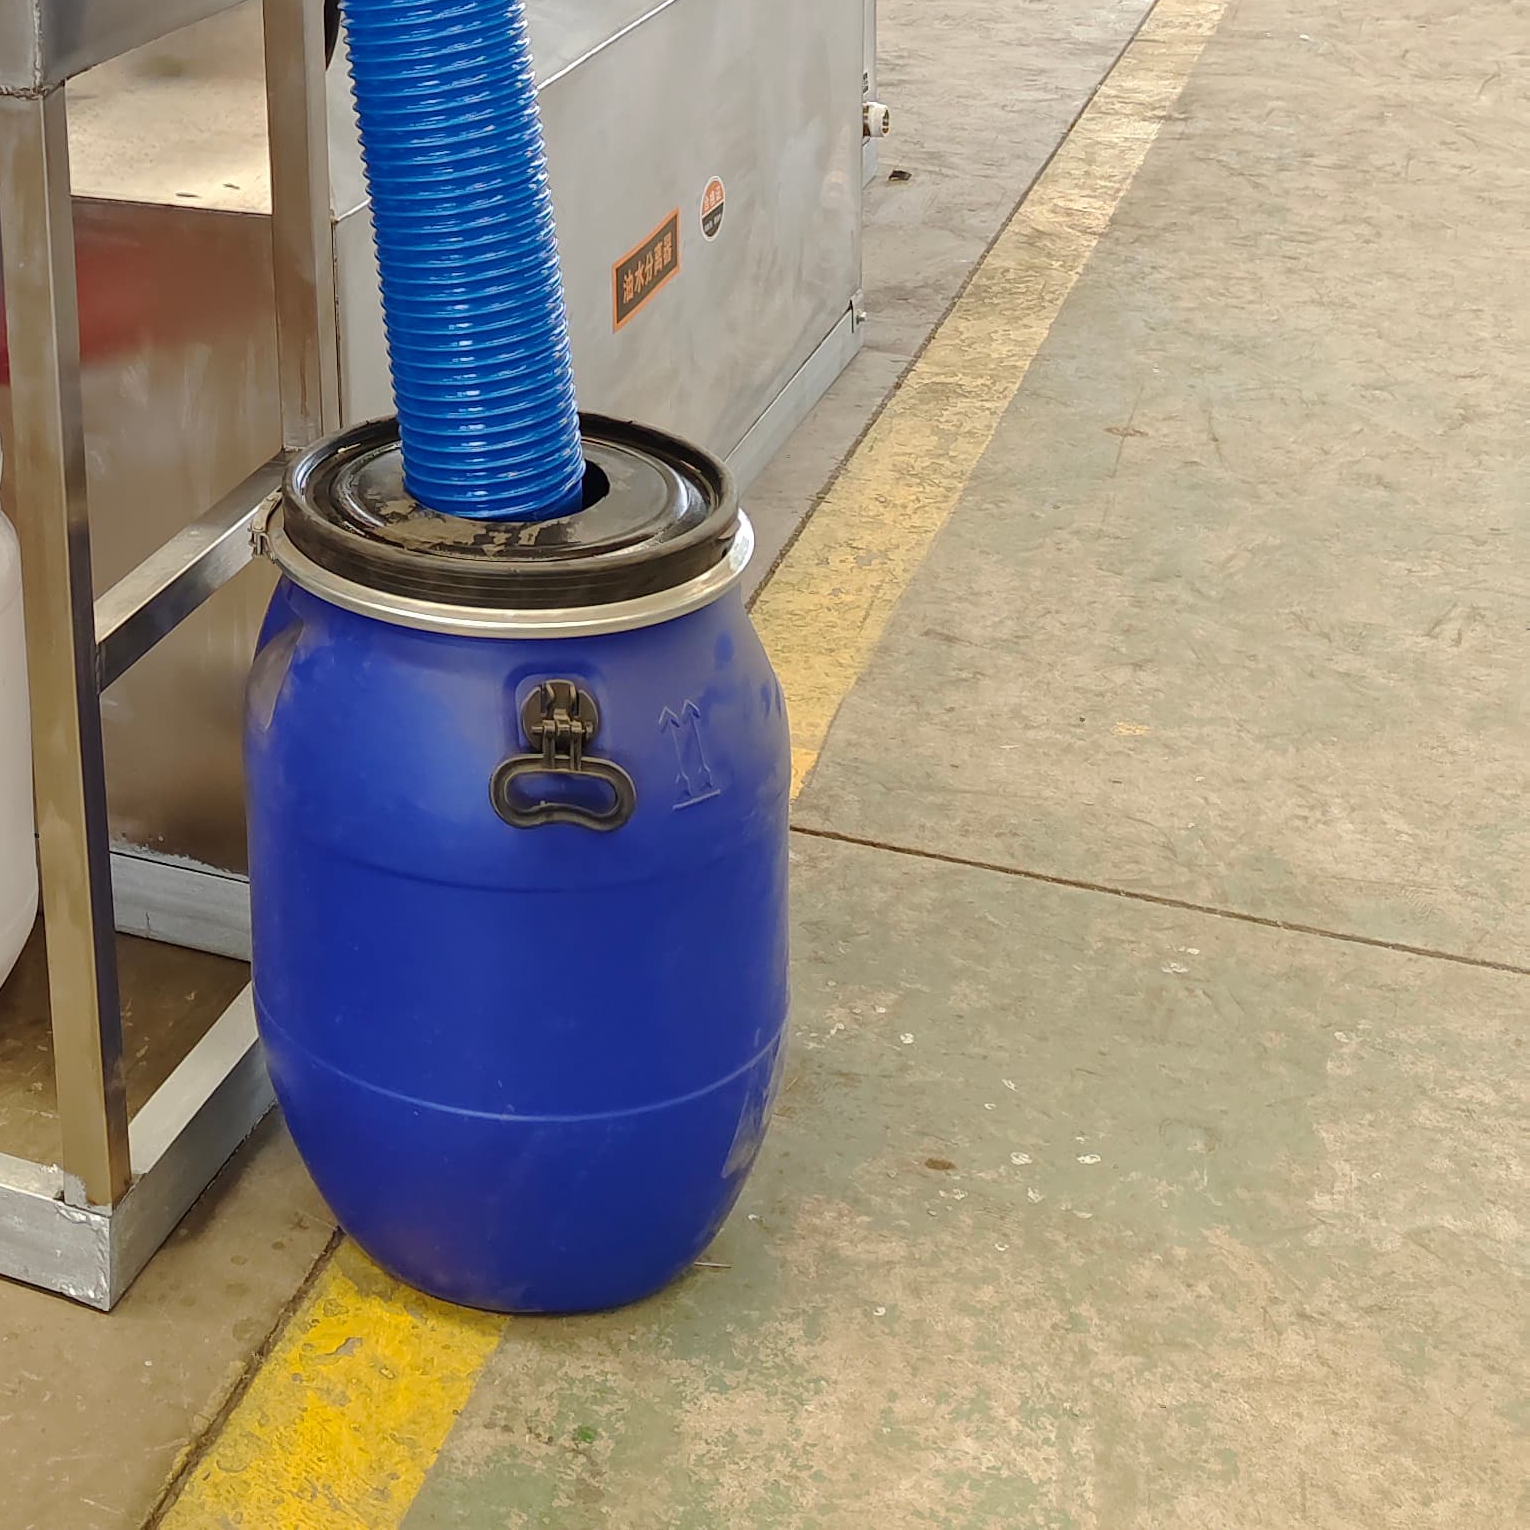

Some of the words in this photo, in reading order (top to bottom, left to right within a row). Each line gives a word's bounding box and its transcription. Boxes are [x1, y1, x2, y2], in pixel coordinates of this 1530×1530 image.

[623, 231, 673, 304] 油水分离器
